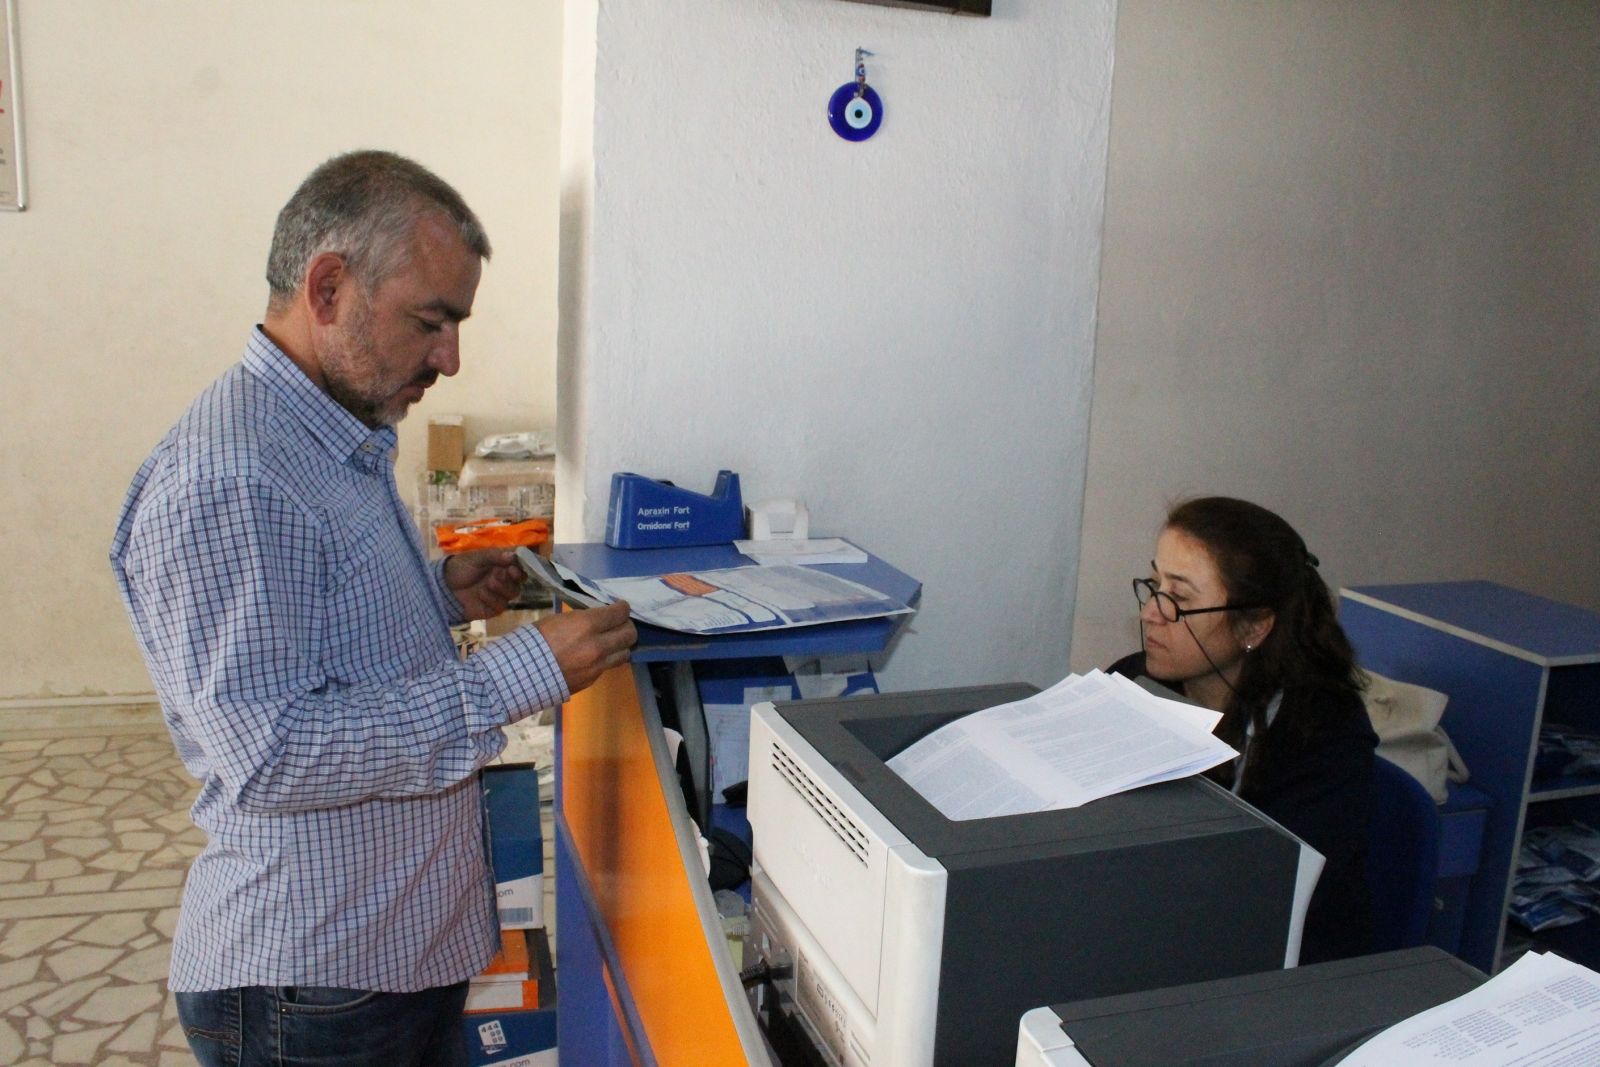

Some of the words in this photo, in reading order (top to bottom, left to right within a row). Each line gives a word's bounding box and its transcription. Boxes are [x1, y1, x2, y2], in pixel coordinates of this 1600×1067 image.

[638, 506, 670, 516] Apraxin
[673, 506, 690, 514] Fort
[637, 521, 672, 530] Ornidone
[674, 520, 690, 529] Fort
